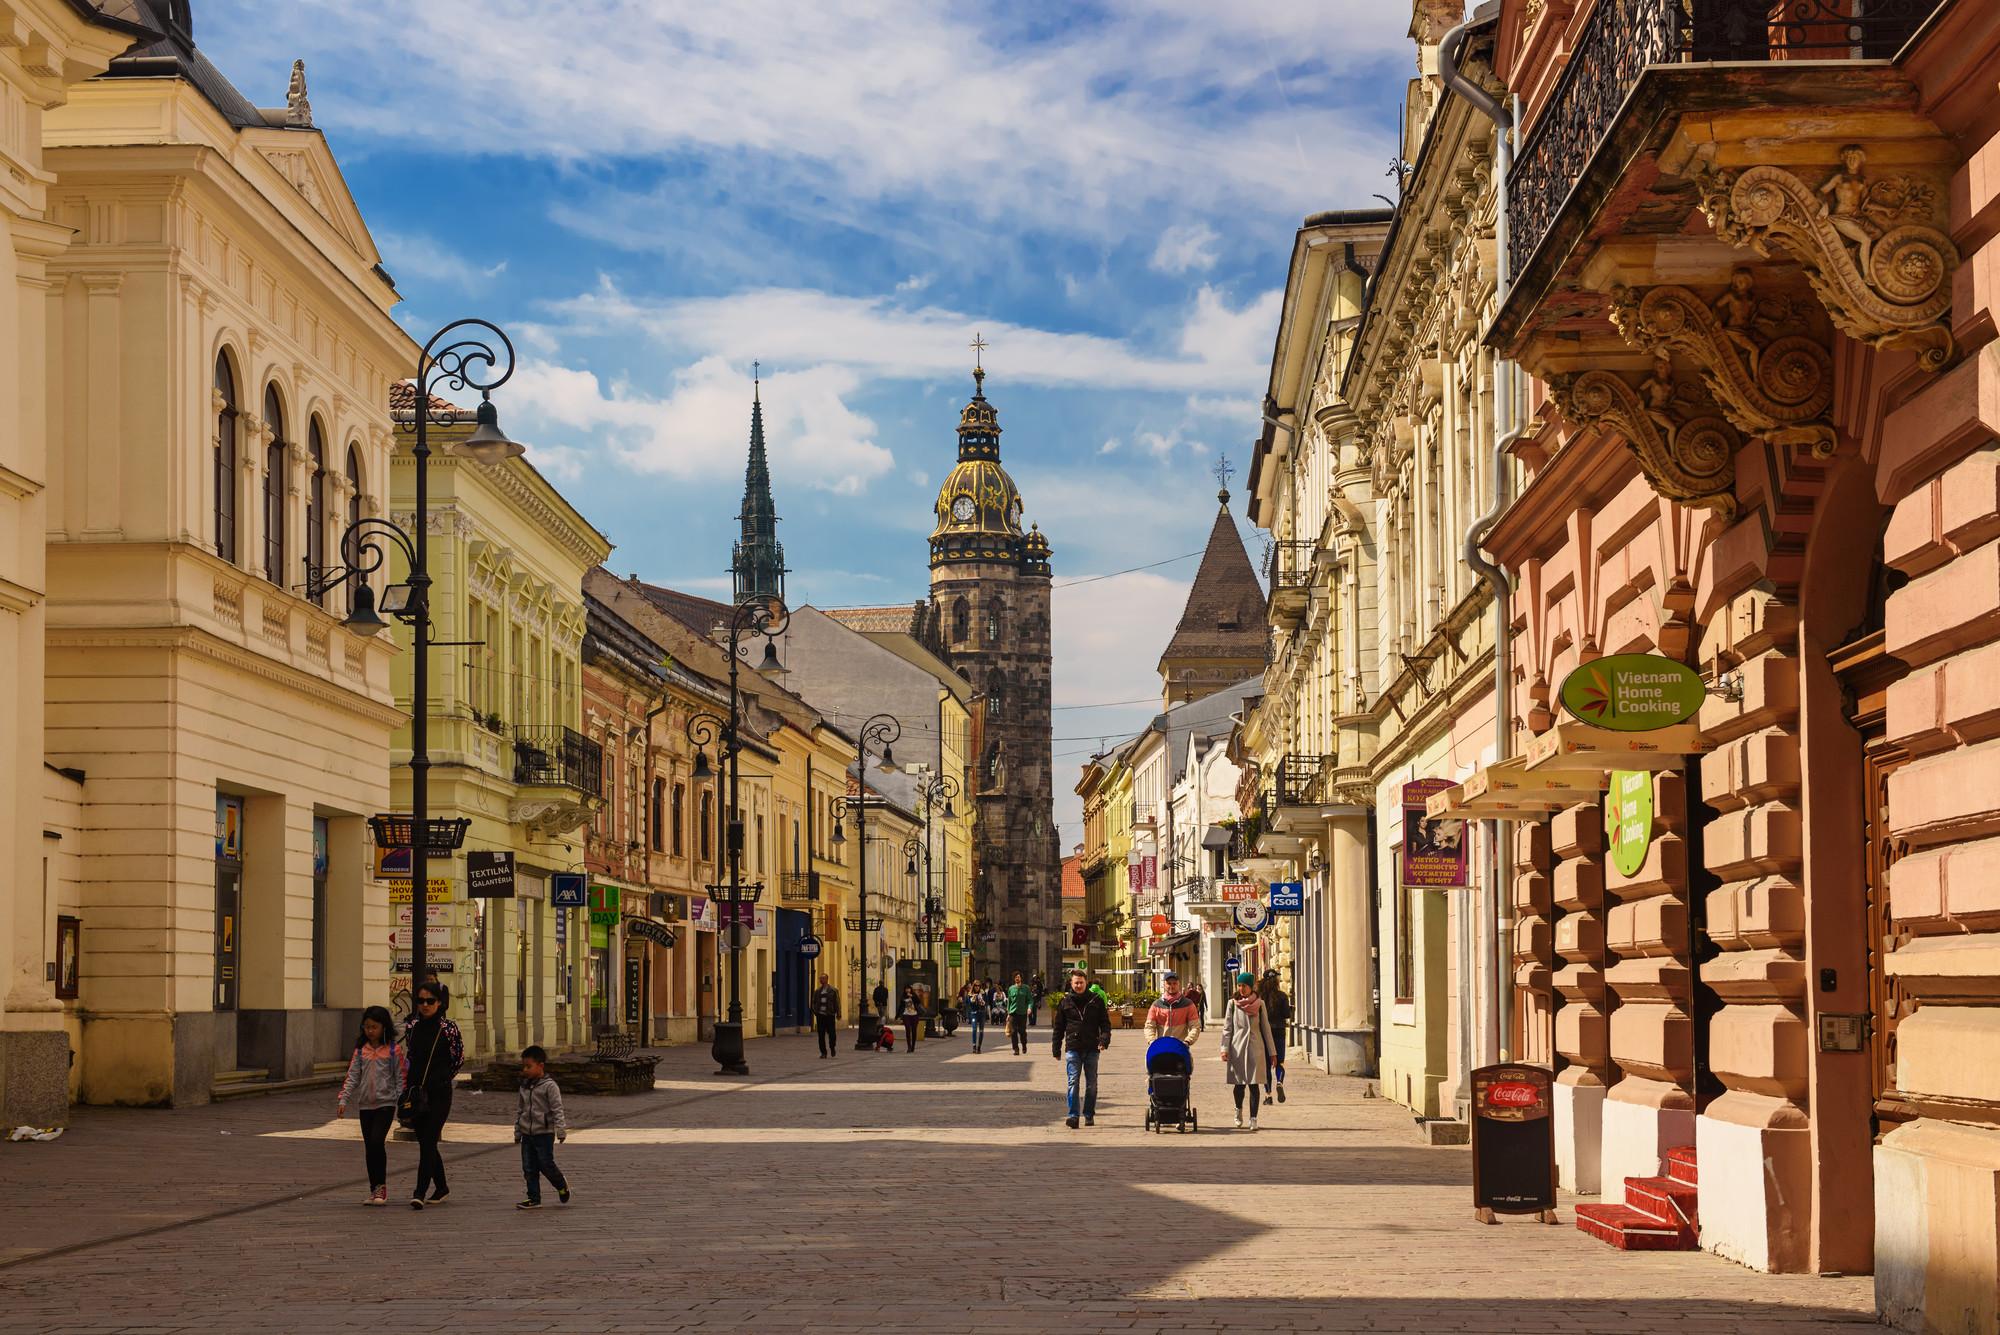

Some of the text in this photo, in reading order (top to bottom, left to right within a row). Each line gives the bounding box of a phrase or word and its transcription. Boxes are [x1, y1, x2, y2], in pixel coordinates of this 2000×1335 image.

[1617, 672, 1682, 684] Vietnam
[1618, 686, 1663, 699] Home
[1619, 700, 1681, 715] Cooking
[1622, 772, 1644, 796] Vietnam
[1622, 800, 1637, 820] Home
[1622, 819, 1644, 845] Cooking
[470, 864, 510, 879] TEXTILNÁ
[556, 889, 578, 900] AXA
[1273, 896, 1299, 906] ČSOB
[592, 912, 618, 925] DAY
[634, 922, 672, 948] BICYKLE
[631, 964, 639, 1018] BICYKLE
